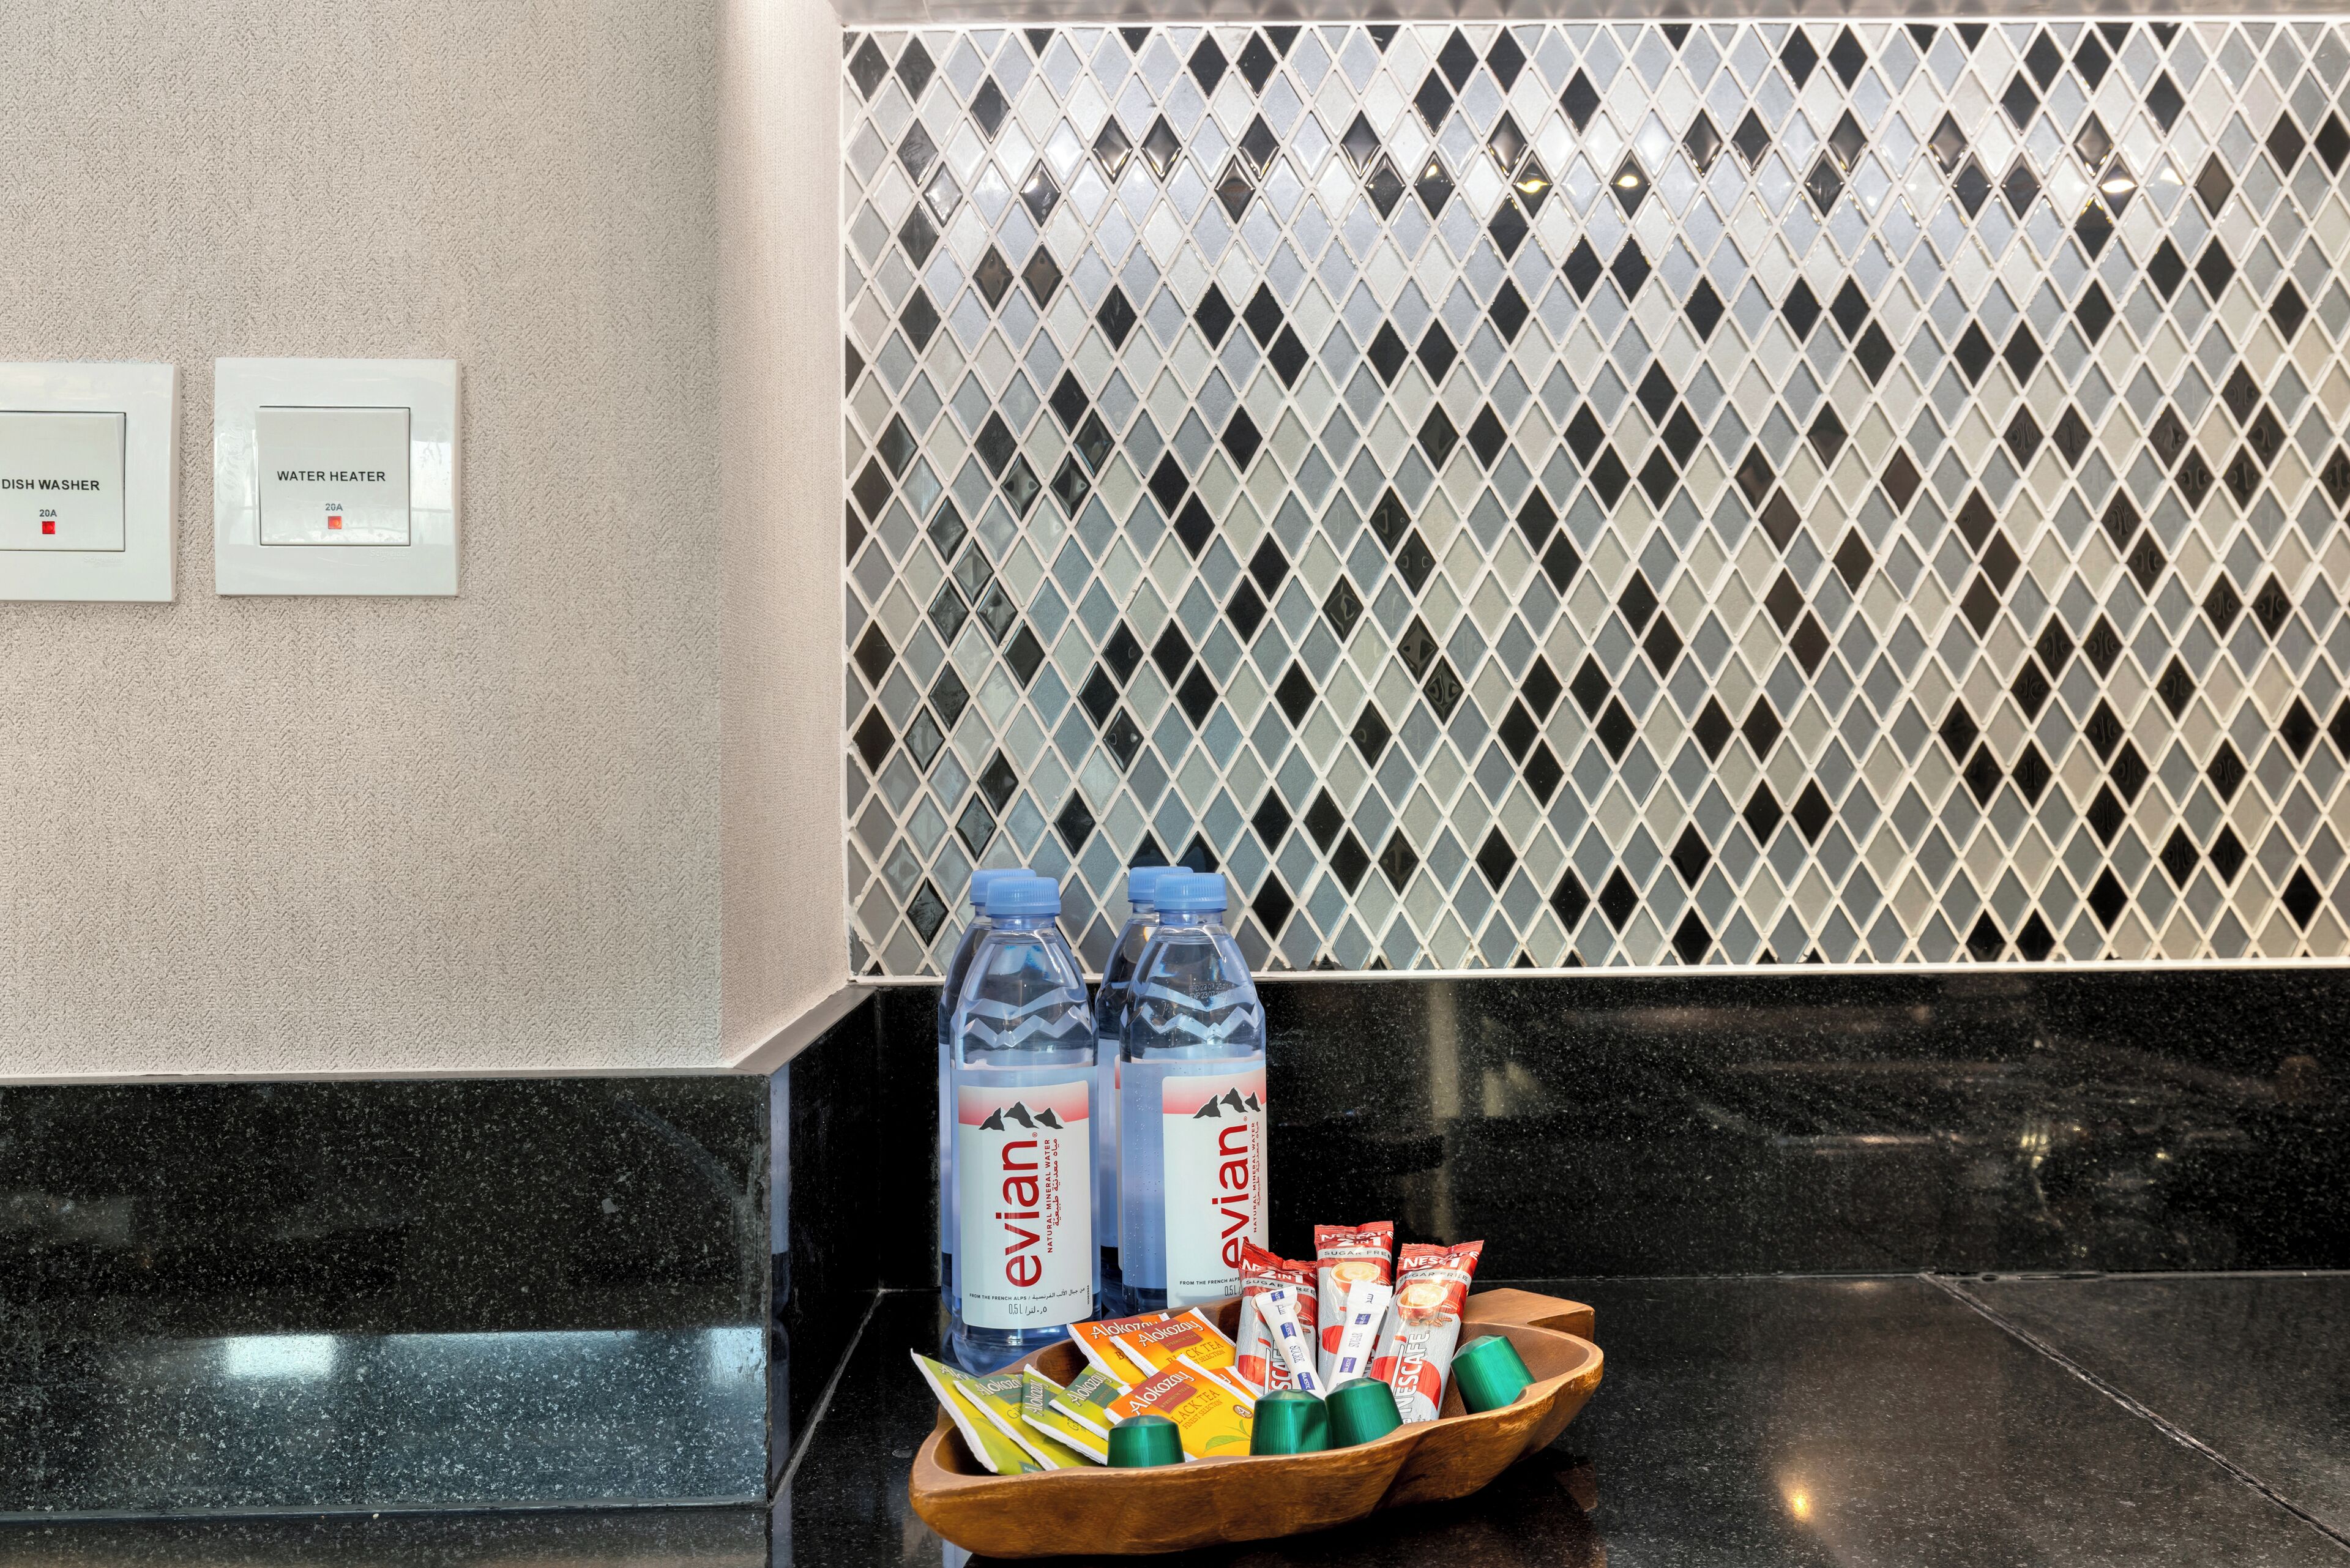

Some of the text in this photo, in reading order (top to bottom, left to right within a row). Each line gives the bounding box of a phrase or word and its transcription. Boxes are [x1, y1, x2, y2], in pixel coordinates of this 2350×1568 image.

[2, 479, 100, 490] DISH WASHER
[277, 471, 386, 482] WATER HEATER
[1212, 1124, 1250, 1268] evian
[996, 1140, 1042, 1287] evian
[1367, 1250, 1391, 1260] FREE
[1245, 1280, 1316, 1296] SUGAR REE
[1138, 1320, 1204, 1346] Alokozay
[1348, 1332, 1363, 1348] SUGAR
[1200, 1340, 1225, 1352] TEA
[1289, 1345, 1305, 1364] SUCRE
[1199, 1349, 1226, 1362] SELECTION
[974, 1379, 1023, 1396] Alokoza
[1067, 1372, 1113, 1406] Alokozay
[1301, 1372, 1311, 1390] MAJESTIC
[1024, 1379, 1050, 1417] Alokozay
[1129, 1371, 1195, 1416] Alokozay
[1171, 1389, 1220, 1425] LACK TEA
[1182, 1399, 1223, 1430] FINEST SELECTION
